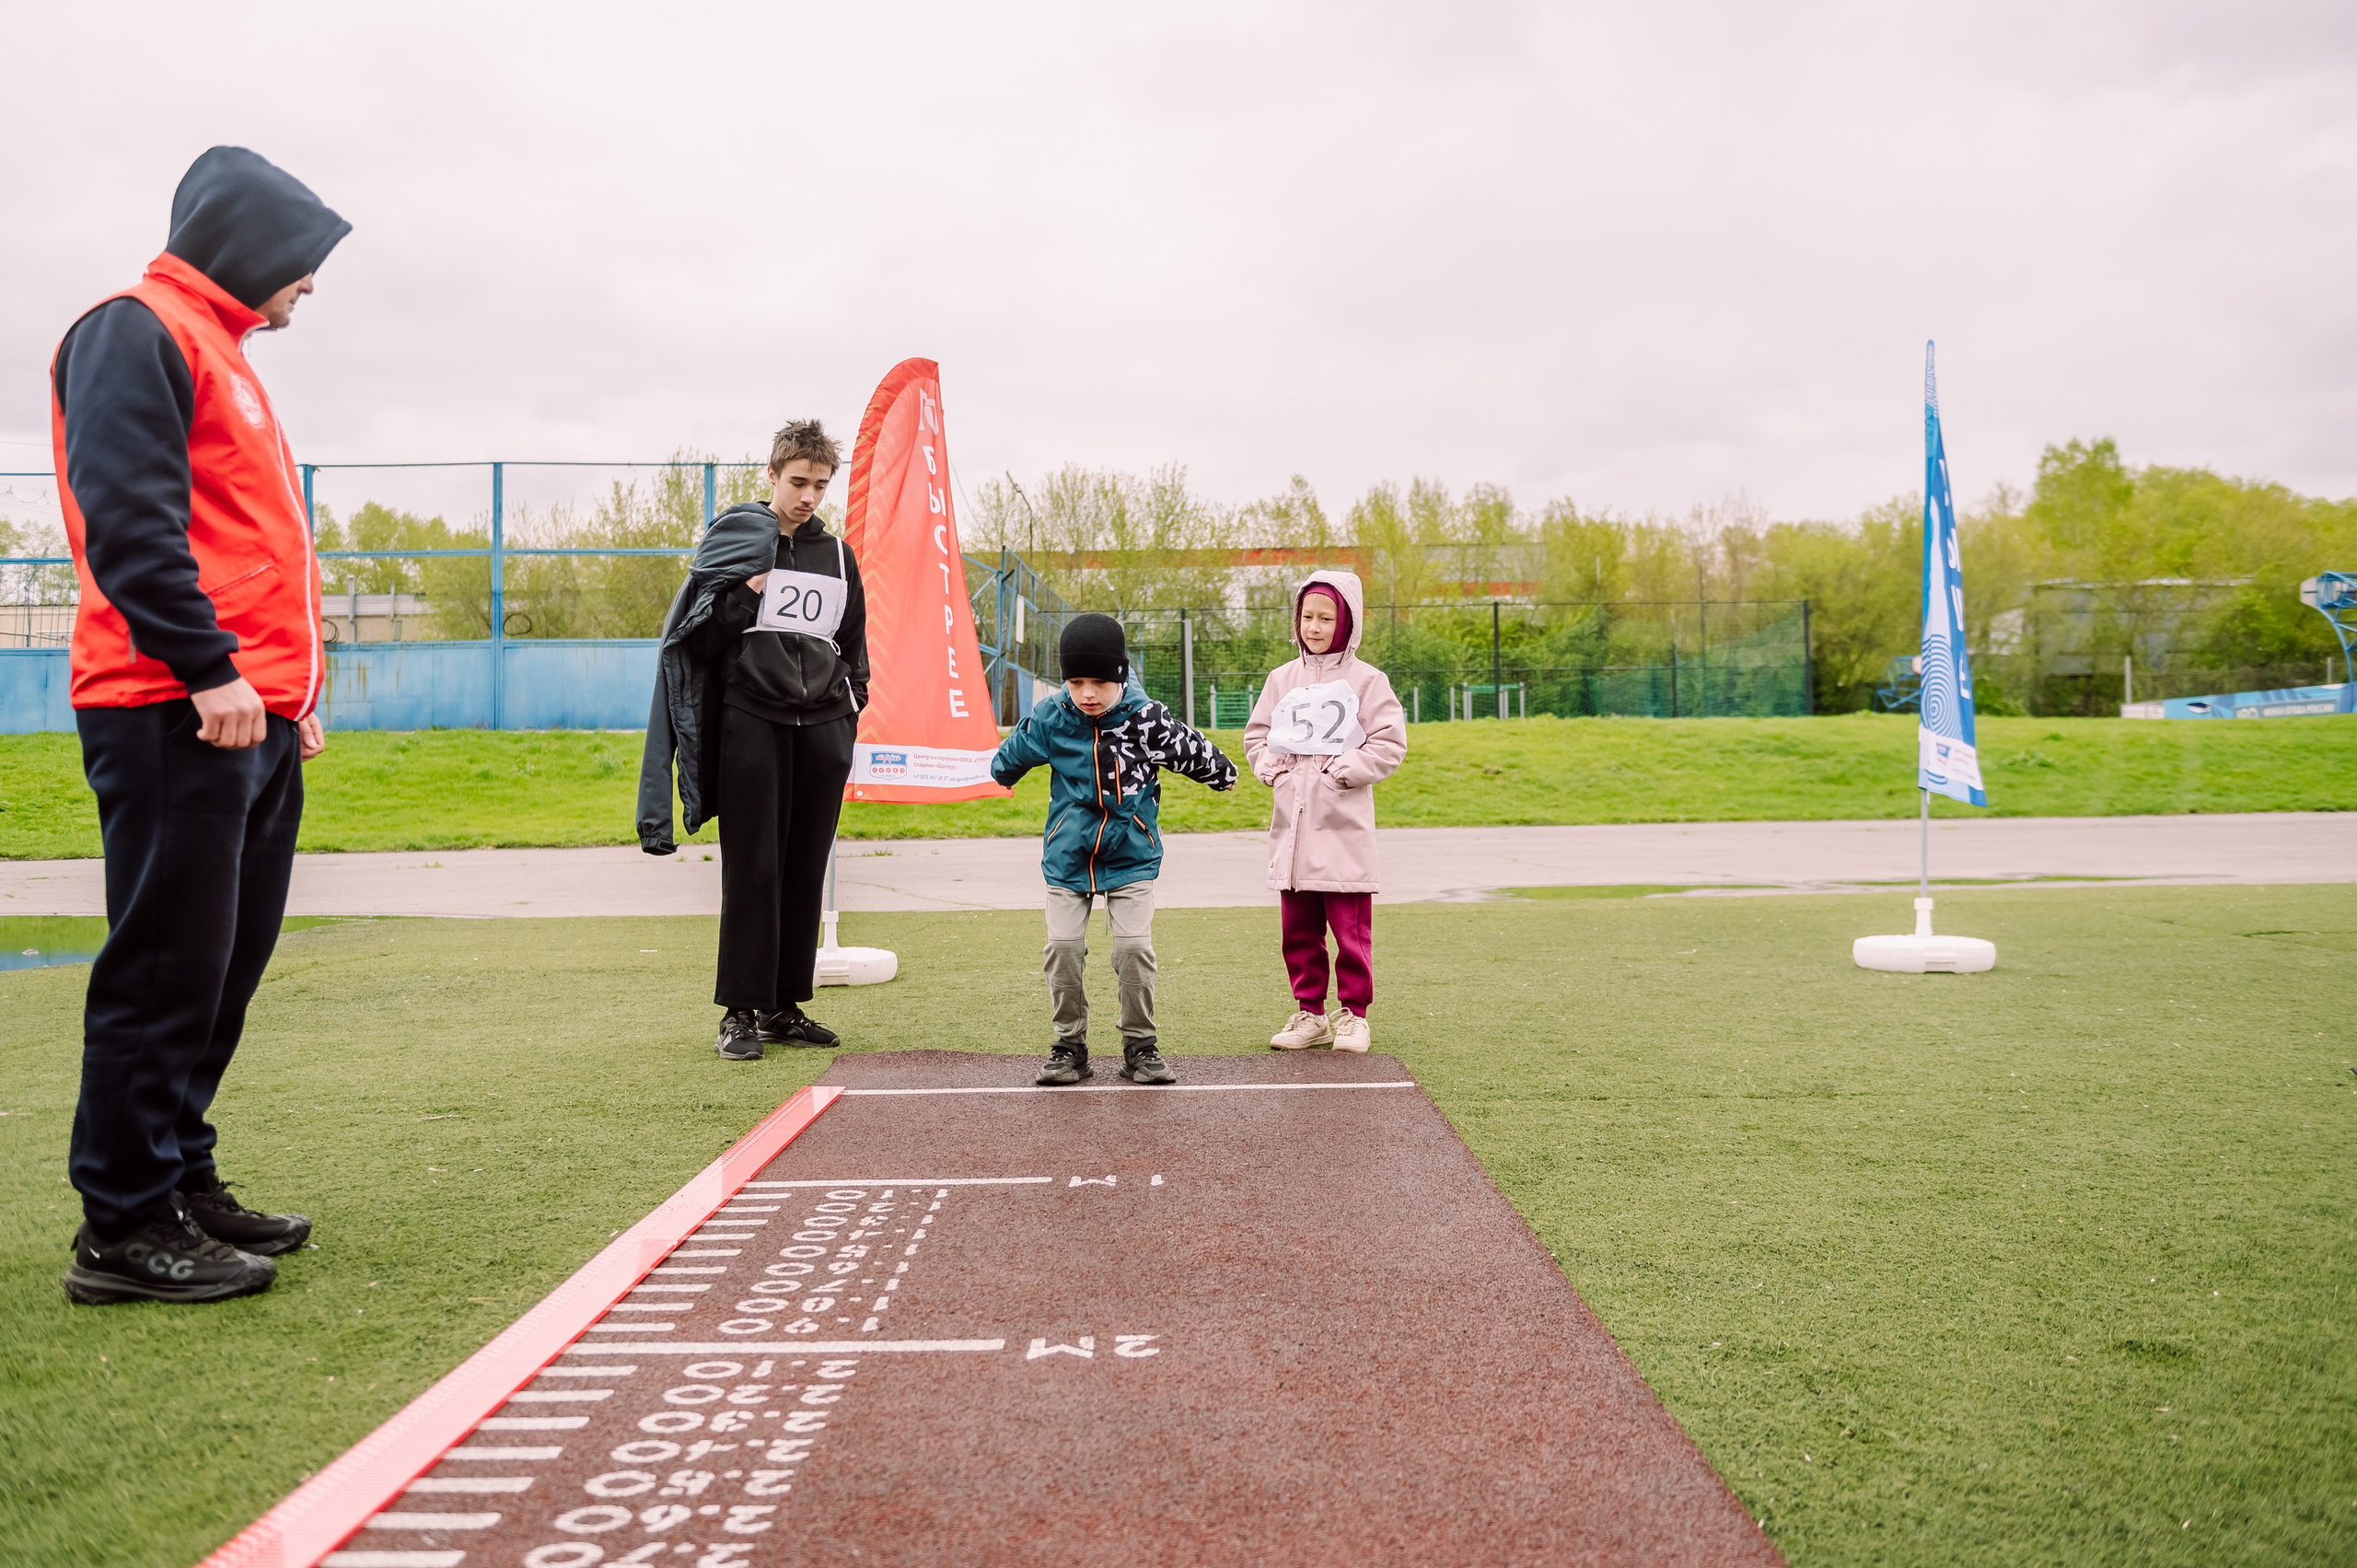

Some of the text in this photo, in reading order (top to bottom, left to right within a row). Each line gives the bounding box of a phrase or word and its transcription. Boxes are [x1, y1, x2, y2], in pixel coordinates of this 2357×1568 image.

[923, 446, 970, 718] БЫСТРЕЕ
[776, 585, 822, 622] 20
[1289, 700, 1346, 743] 52
[1151, 1174, 1165, 1187] 1
[825, 1188, 948, 1201] 1.10
[815, 1201, 942, 1214] 1.20
[779, 1243, 919, 1259] 1.50
[764, 1260, 910, 1276] 1.60
[749, 1277, 900, 1294] 1.70
[716, 1316, 879, 1335] 1.90
[1114, 1333, 1161, 1358] 2
[683, 1359, 861, 1379] 2.10
[662, 1383, 845, 1405] 2.20
[637, 1410, 831, 1434] 2.30
[610, 1438, 815, 1464] 2.40
[583, 1469, 795, 1498] 2.50
[553, 1504, 779, 1535] 2.60
[523, 1540, 757, 1568] 2.70
